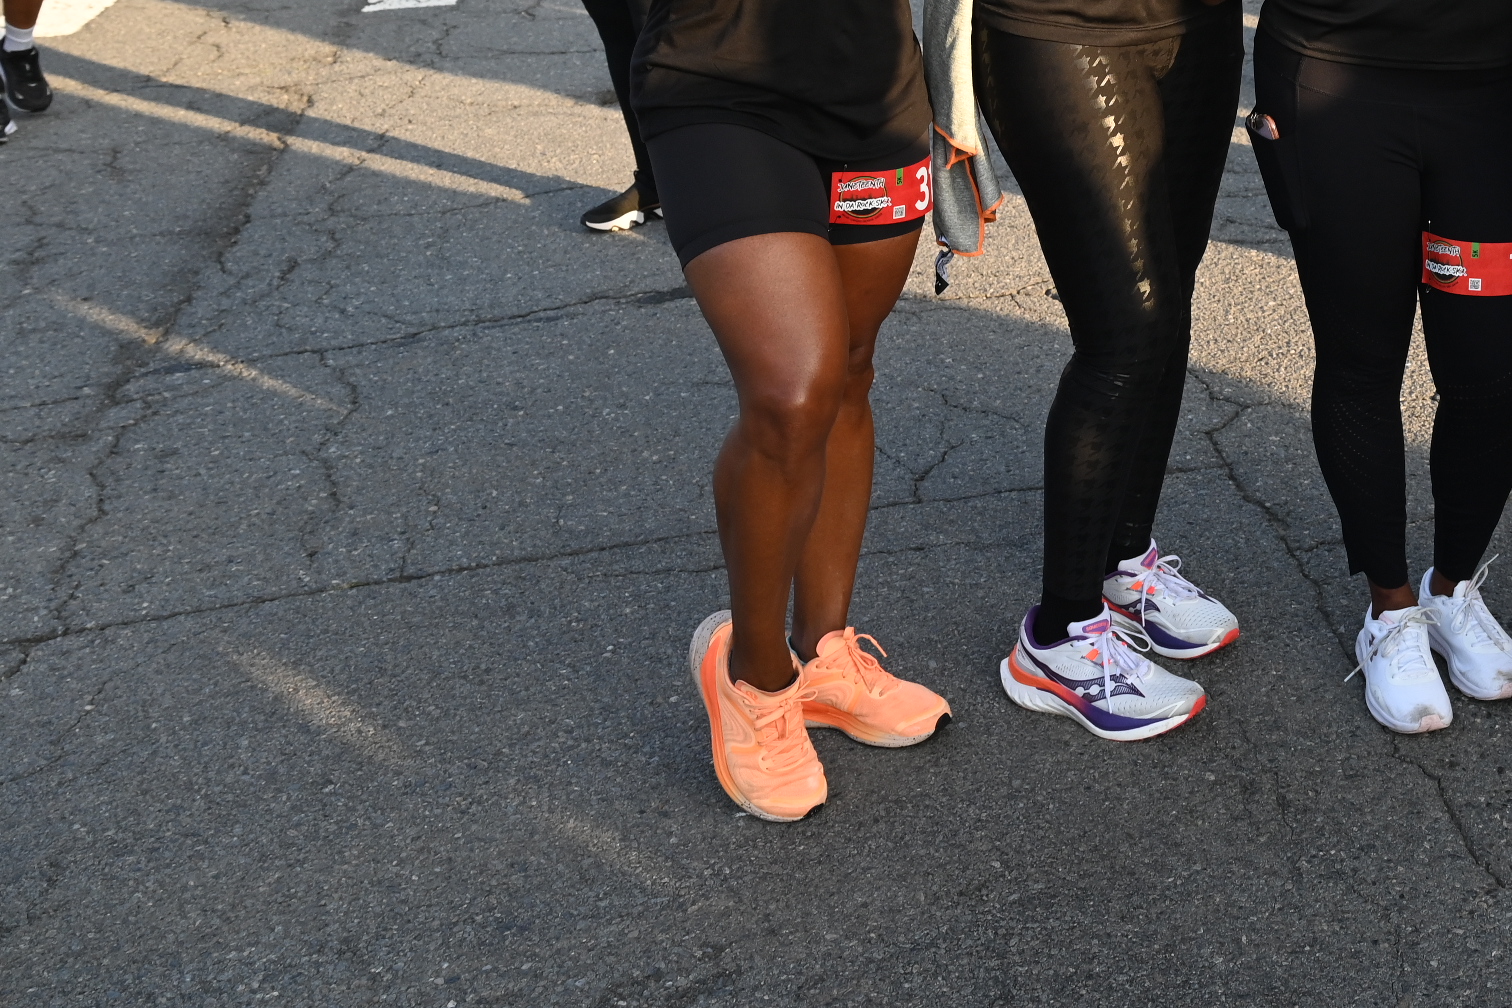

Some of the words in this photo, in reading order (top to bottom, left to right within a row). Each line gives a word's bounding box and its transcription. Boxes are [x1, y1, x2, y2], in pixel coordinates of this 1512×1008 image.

[838, 177, 886, 192] JUNETEENTH
[835, 202, 843, 210] IN
[845, 201, 855, 209] DA
[856, 199, 874, 209] ROCK
